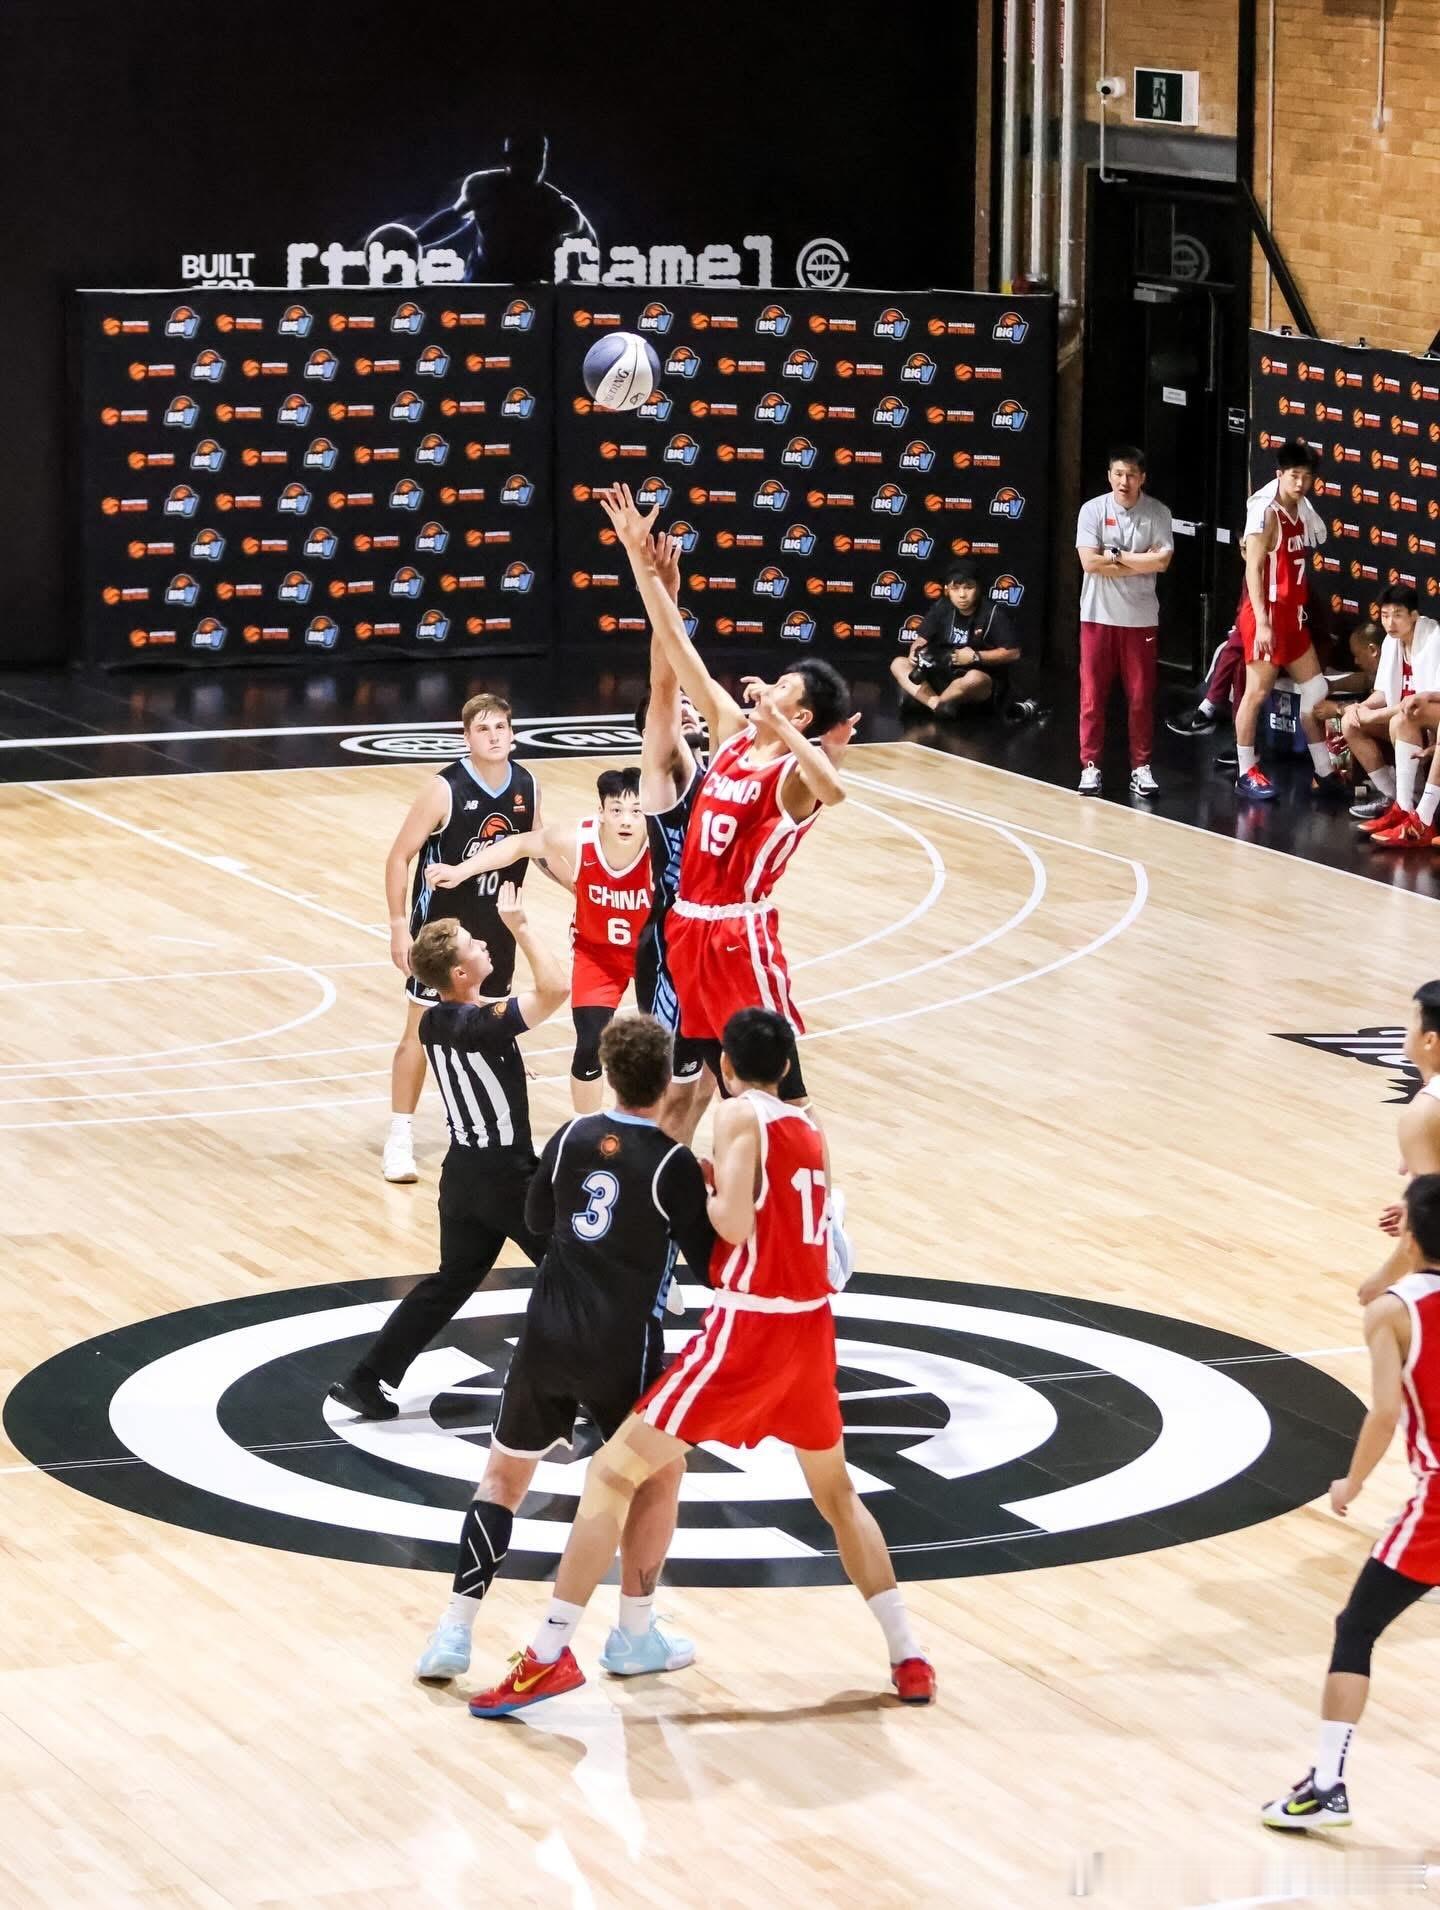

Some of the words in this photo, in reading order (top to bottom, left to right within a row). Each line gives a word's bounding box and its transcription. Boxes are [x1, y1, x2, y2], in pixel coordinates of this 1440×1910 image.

[181, 253, 256, 278] BUILT
[1293, 558, 1305, 585] 7
[702, 771, 763, 805] CHINA
[699, 810, 738, 857] 19
[477, 871, 499, 897] 10
[588, 884, 652, 911] CHINA
[607, 917, 632, 946] 6
[571, 1170, 621, 1242] 3
